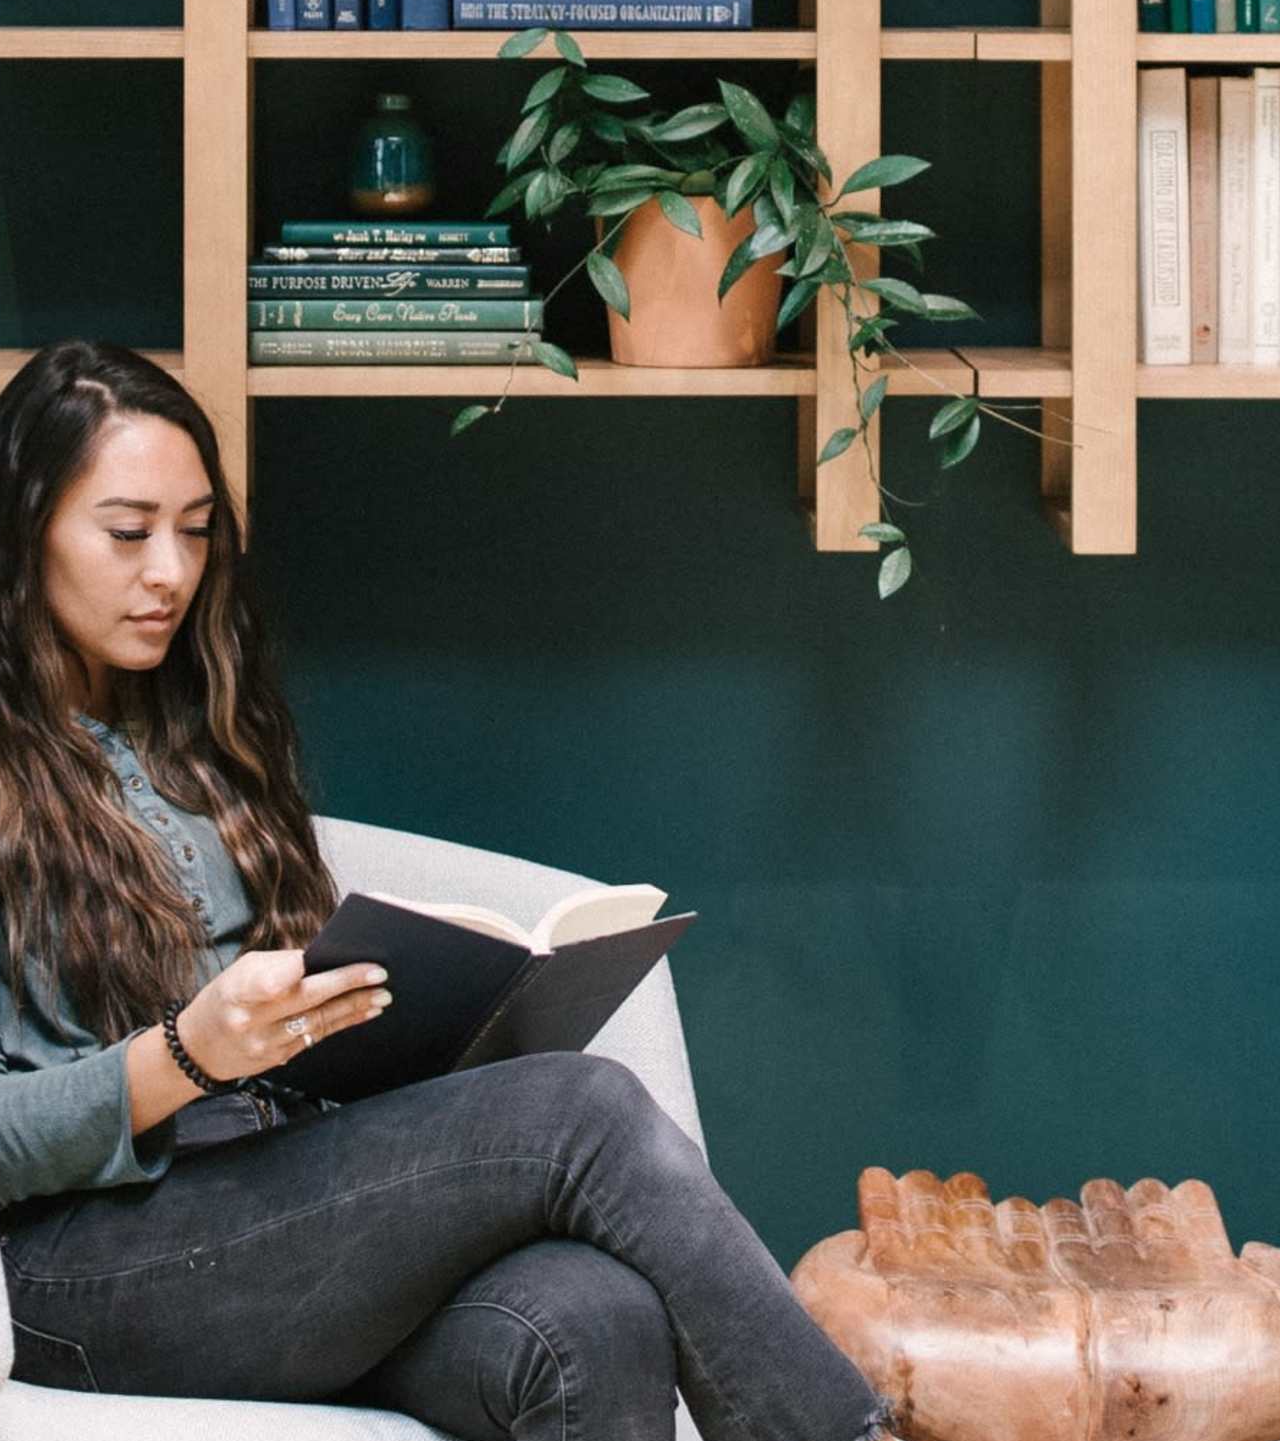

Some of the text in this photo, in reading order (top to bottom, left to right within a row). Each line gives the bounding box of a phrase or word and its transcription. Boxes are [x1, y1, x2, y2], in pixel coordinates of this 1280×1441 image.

[487, 3, 508, 20] THE
[510, 3, 618, 22] STRATEGY-FOCUSED
[619, 4, 702, 22] ORGANIZATION
[1154, 132, 1176, 304] COACHING FOR LEADERSHIP
[372, 230, 383, 243] T.
[249, 277, 268, 288] THE
[272, 277, 327, 290] PURPOSE
[426, 278, 469, 288] WARREN
[332, 303, 479, 323] Easy Care Native Plants
